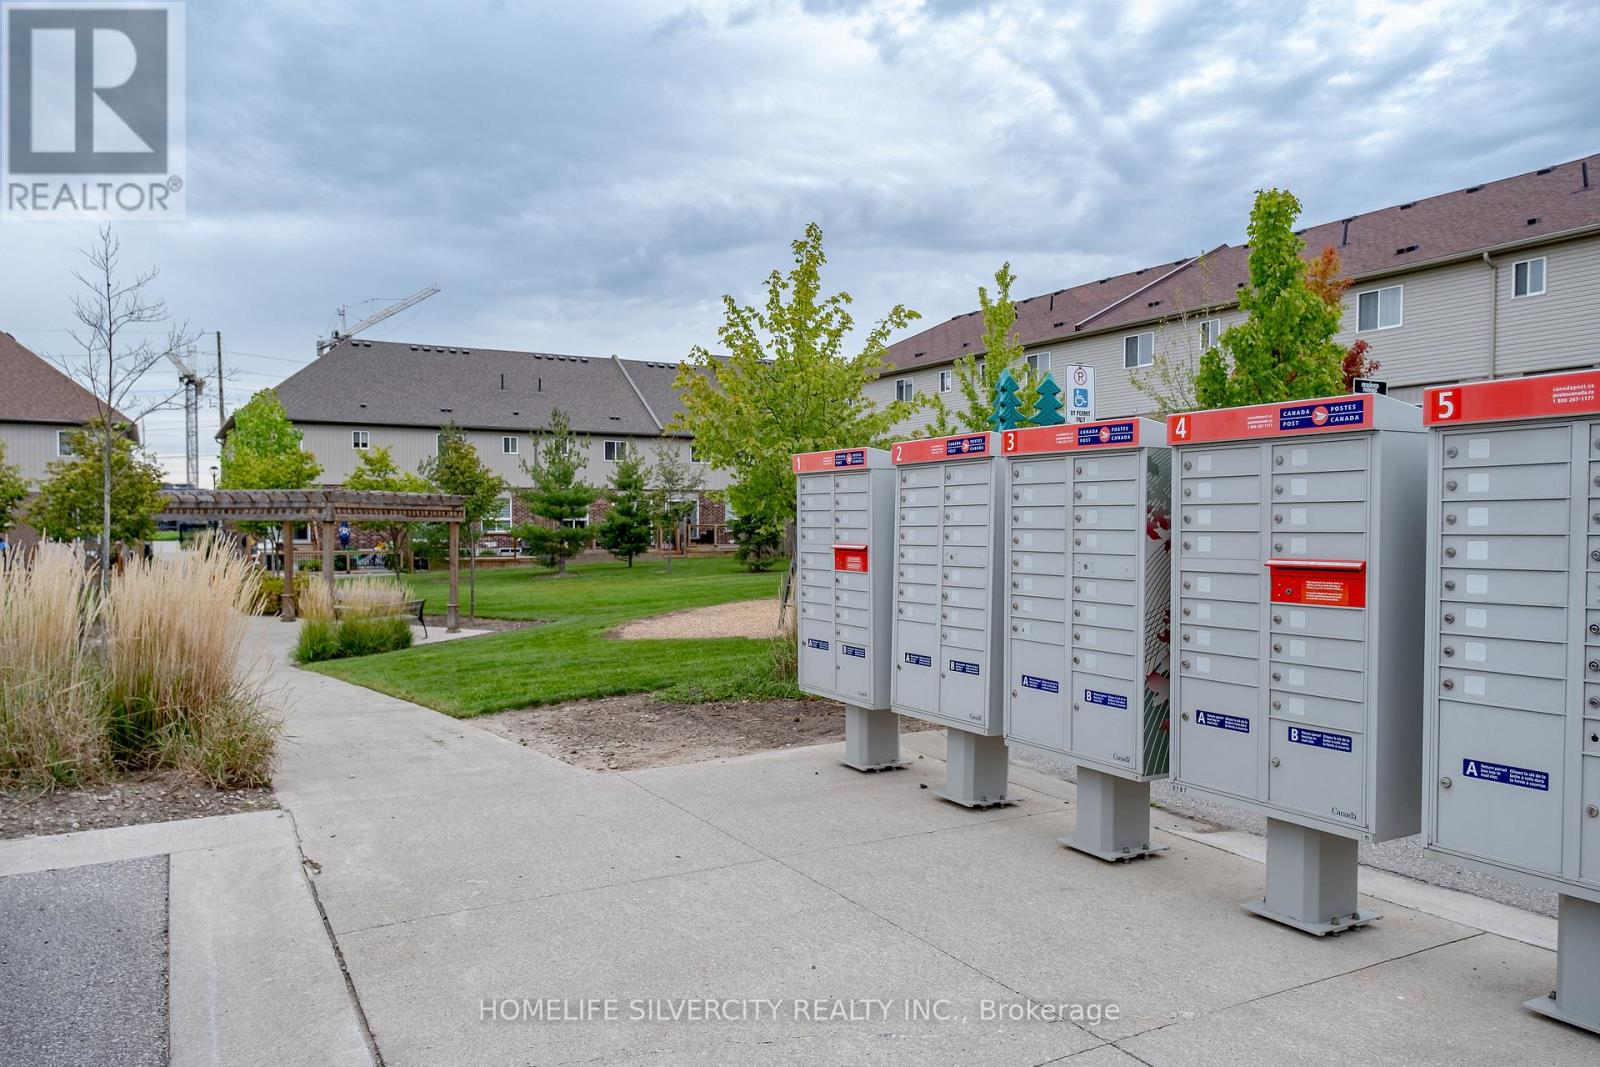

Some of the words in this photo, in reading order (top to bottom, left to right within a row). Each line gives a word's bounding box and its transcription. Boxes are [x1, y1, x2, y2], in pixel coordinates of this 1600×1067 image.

[1438, 391, 1454, 419] 5
[1175, 417, 1186, 439] 4
[1007, 432, 1015, 451] 3
[896, 446, 902, 461] 2
[796, 456, 801, 470] 1
[906, 654, 910, 662] A
[1023, 677, 1029, 686] A
[1087, 691, 1092, 701] B
[1198, 712, 1205, 724] A
[1291, 729, 1299, 741] B
[1466, 761, 1478, 777] A
[1332, 807, 1357, 820] Canada
